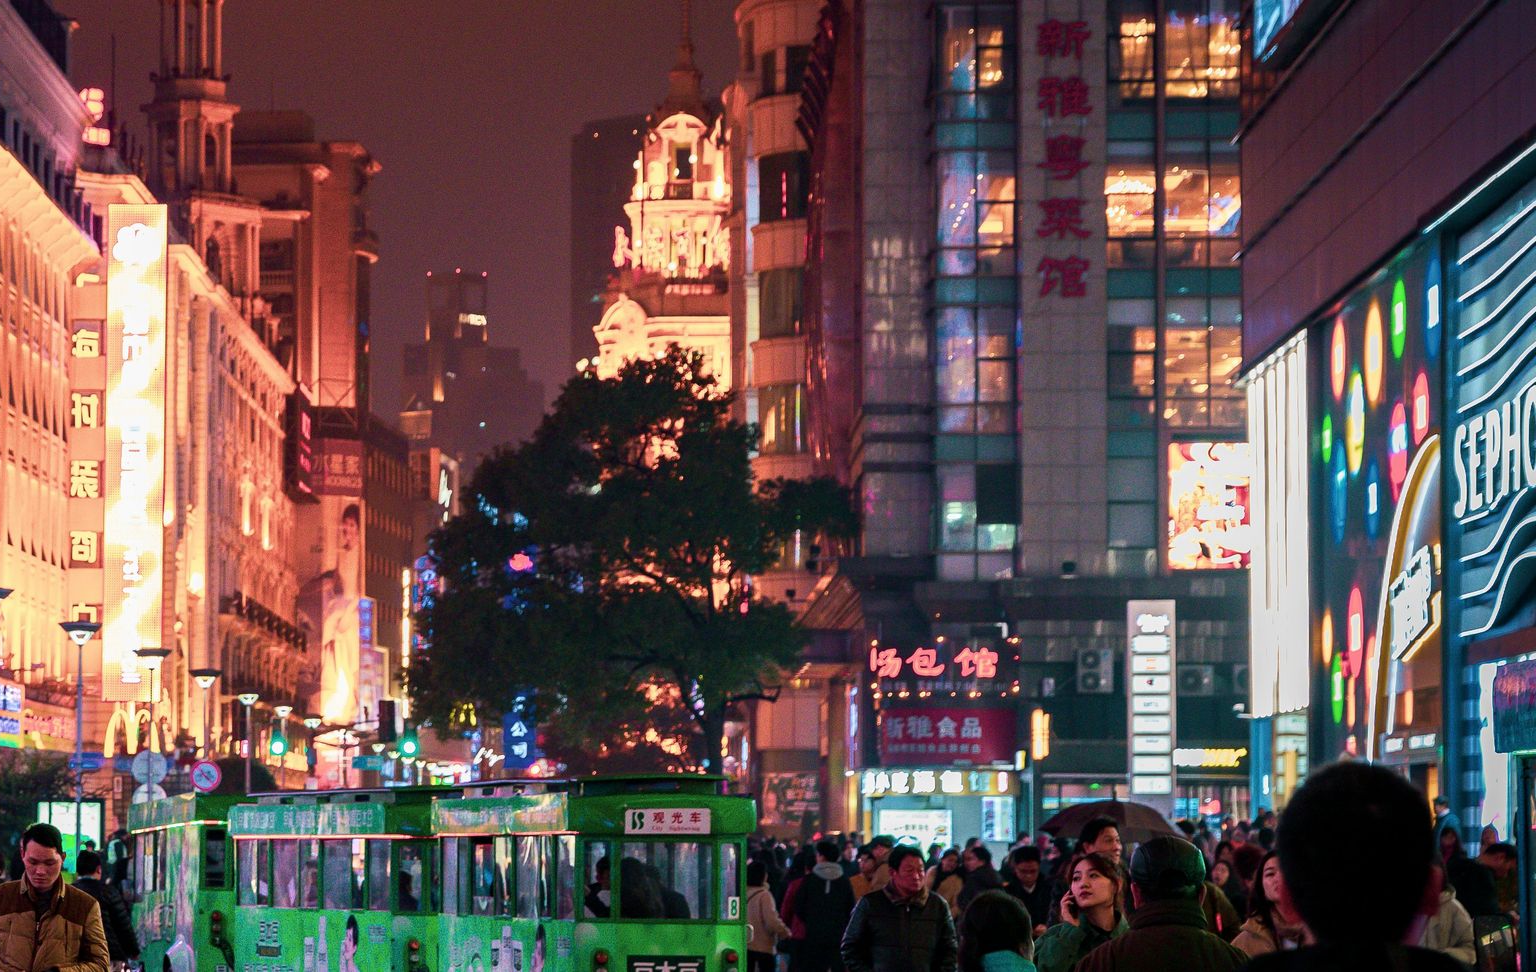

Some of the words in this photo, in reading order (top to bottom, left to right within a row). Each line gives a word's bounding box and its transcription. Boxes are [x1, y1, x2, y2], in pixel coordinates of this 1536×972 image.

[1037, 19, 1091, 298] 新雅粤菜馆
[886, 715, 982, 739] 新雅食品
[652, 811, 702, 824] 观光车
[730, 899, 738, 917] 8
